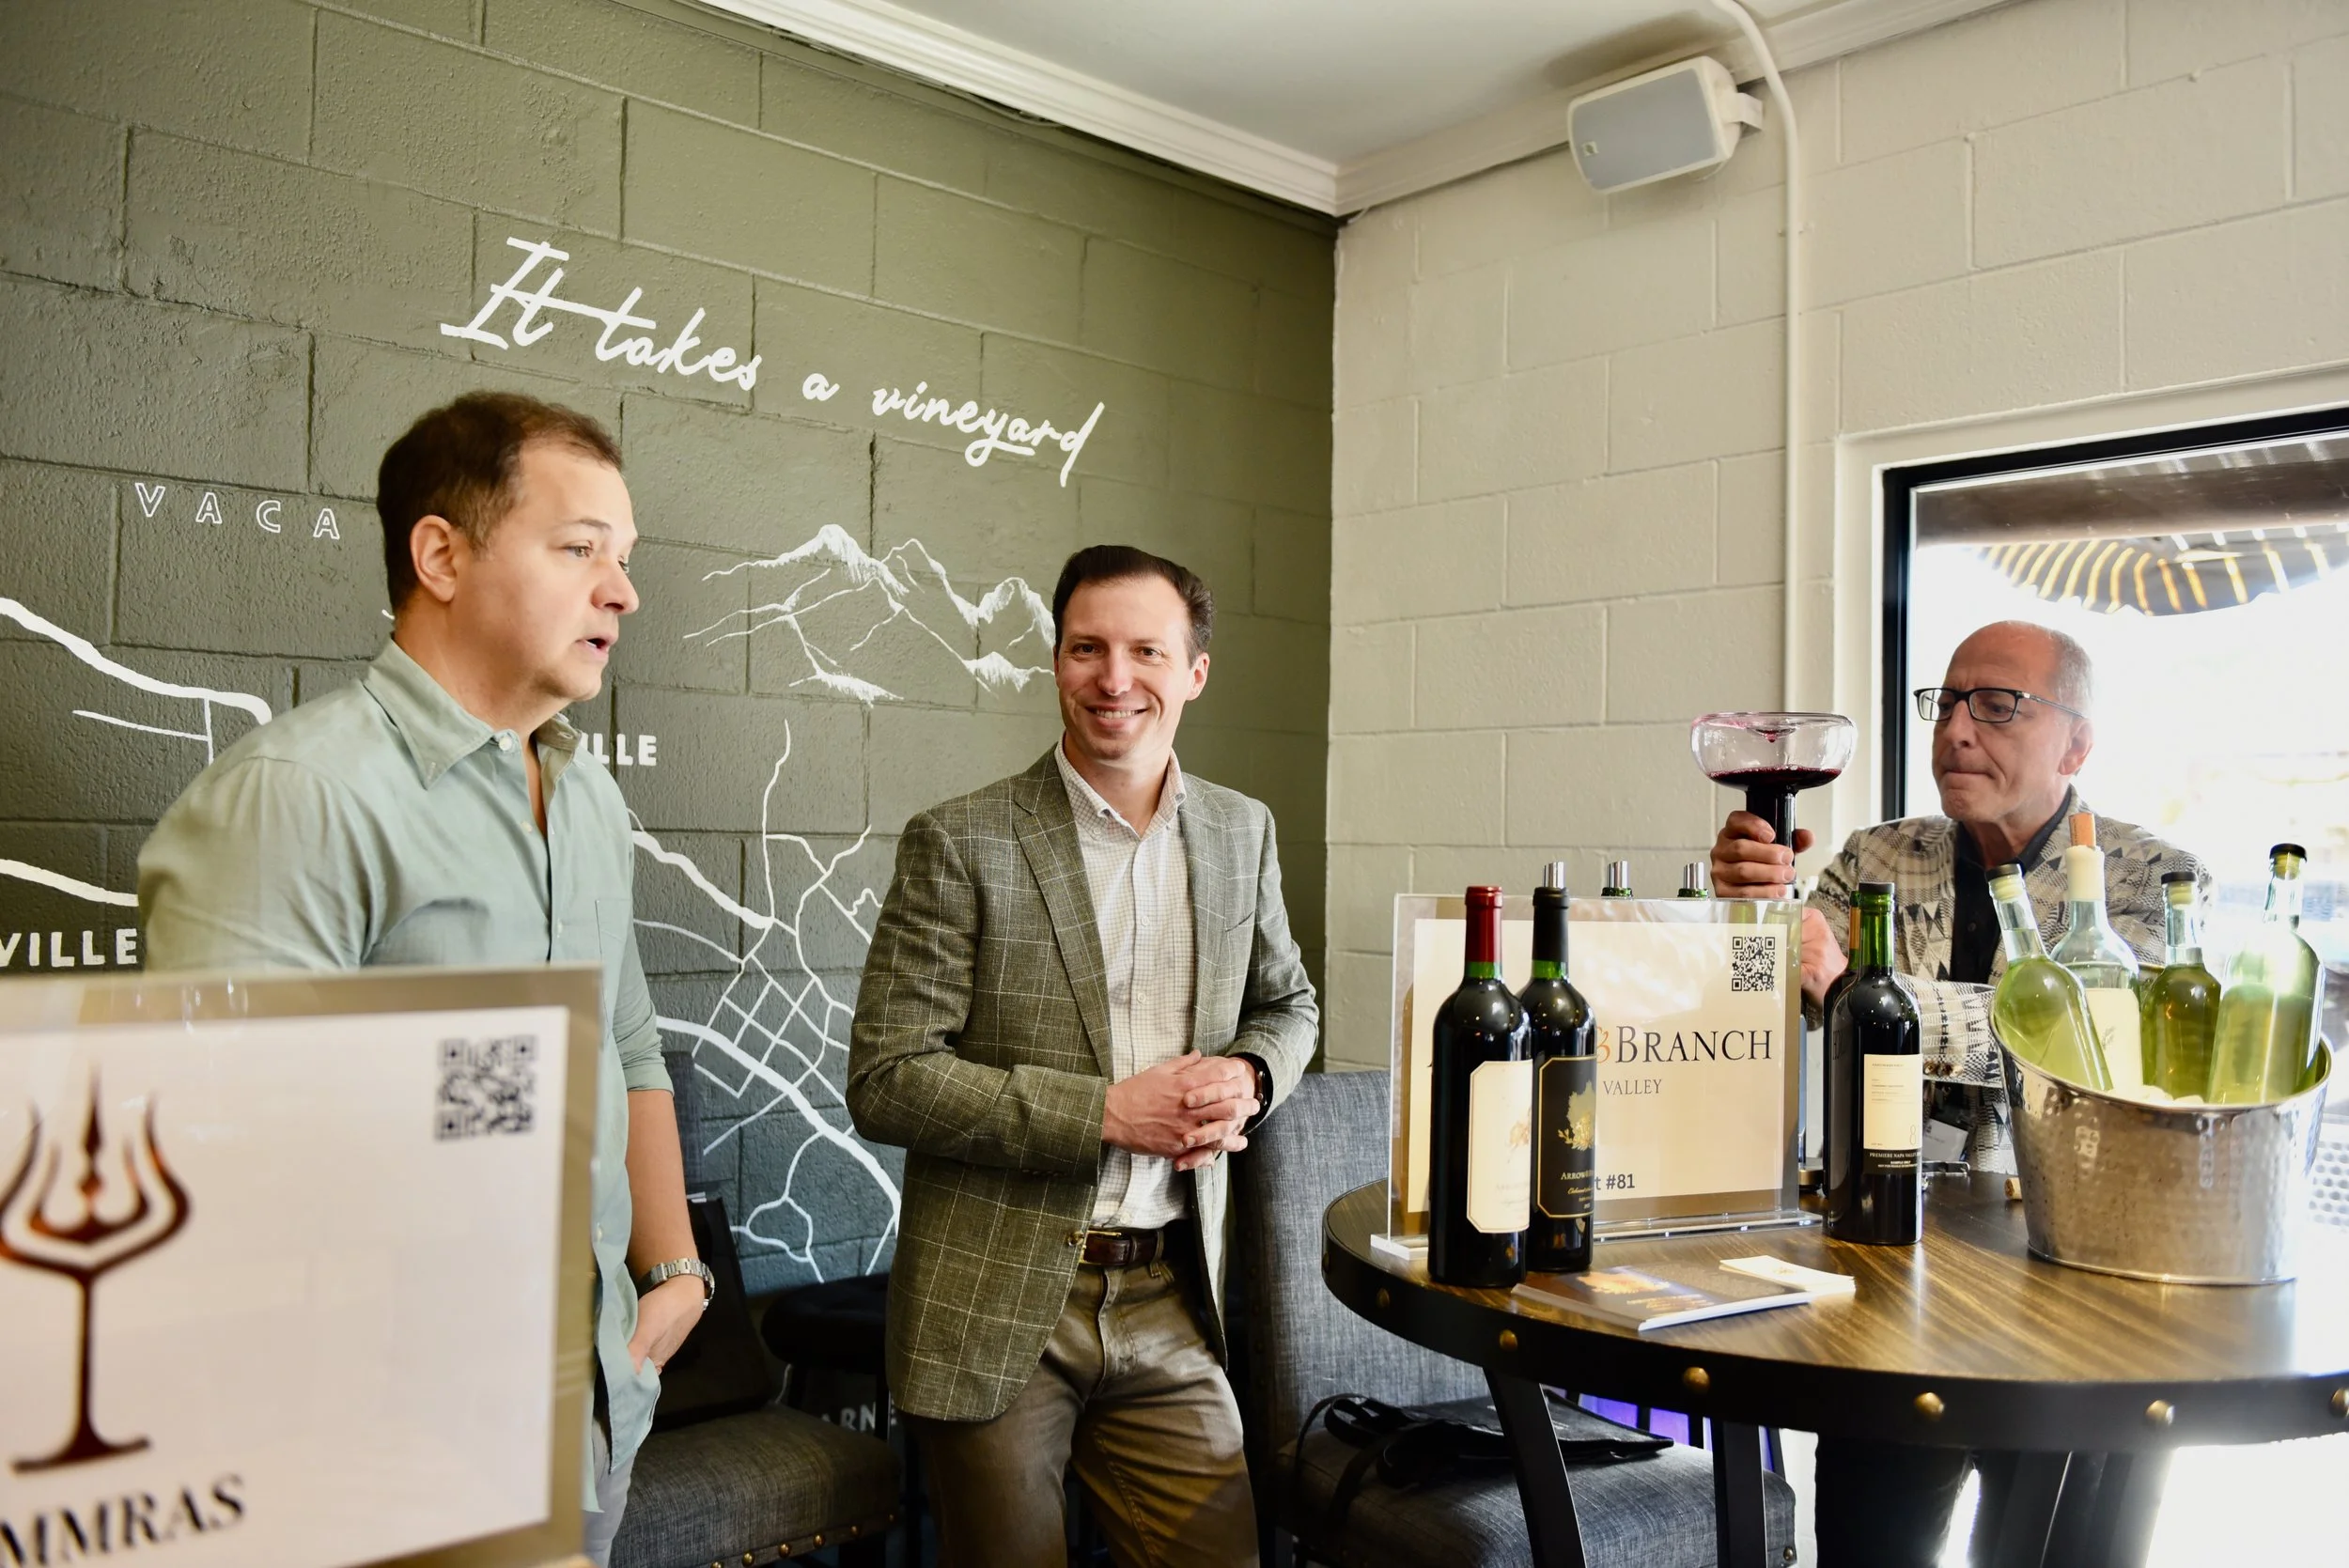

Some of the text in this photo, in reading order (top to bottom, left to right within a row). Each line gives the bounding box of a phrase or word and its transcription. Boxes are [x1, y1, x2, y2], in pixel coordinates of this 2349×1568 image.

[440, 236, 1105, 488] It takes a vineyard
[134, 482, 341, 540] VACA
[0, 928, 138, 968] VILLE
[1602, 1079, 1662, 1095] VALLEY
[1605, 1173, 1636, 1190] #81
